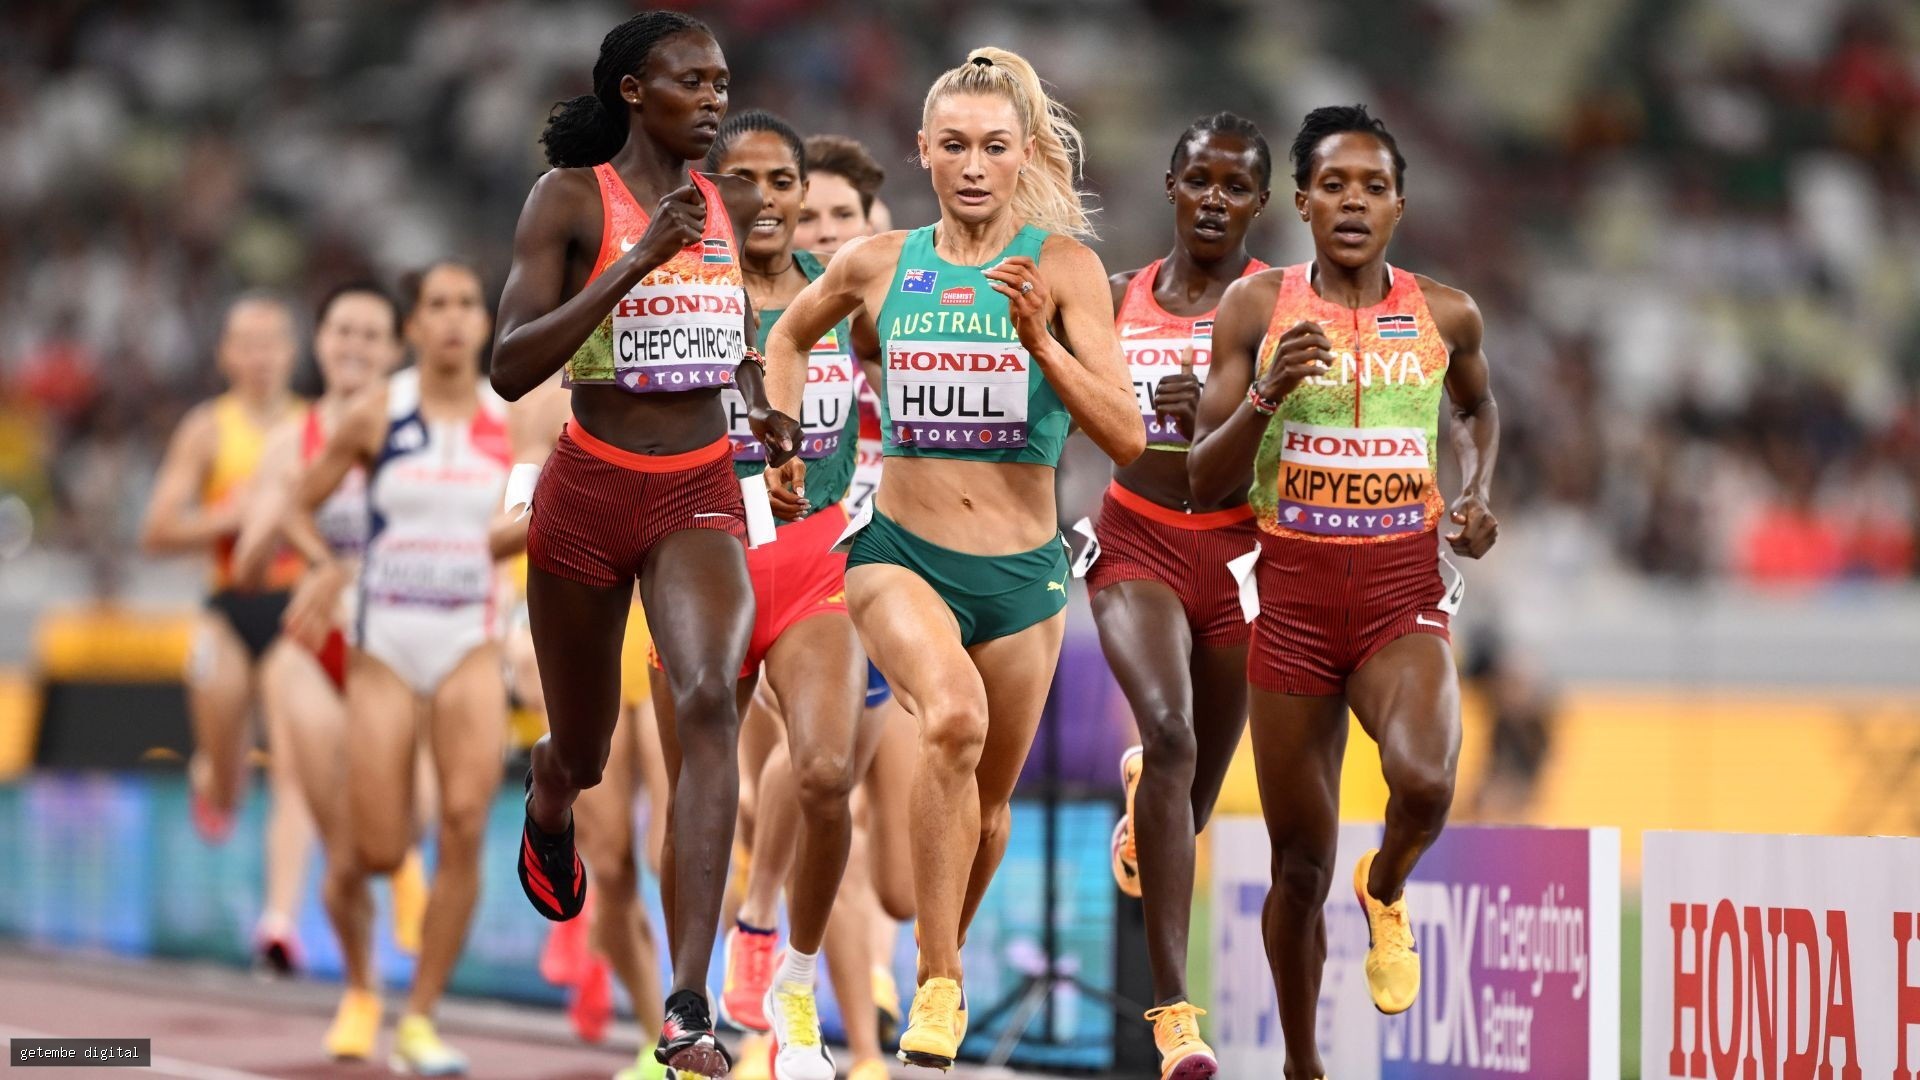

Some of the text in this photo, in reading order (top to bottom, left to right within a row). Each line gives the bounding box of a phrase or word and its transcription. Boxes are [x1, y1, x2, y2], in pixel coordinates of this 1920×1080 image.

[616, 294, 743, 318] HONDA
[619, 327, 743, 362] CHEPCHIRCHIR
[889, 351, 1026, 373] HONDA
[902, 384, 1004, 418] HULL
[913, 428, 993, 443] TOKYO
[1285, 431, 1424, 458] HONDA
[1285, 466, 1424, 505] KIPYEGON
[1312, 512, 1394, 529] TOKYO
[1669, 898, 1862, 1080] HONDA
